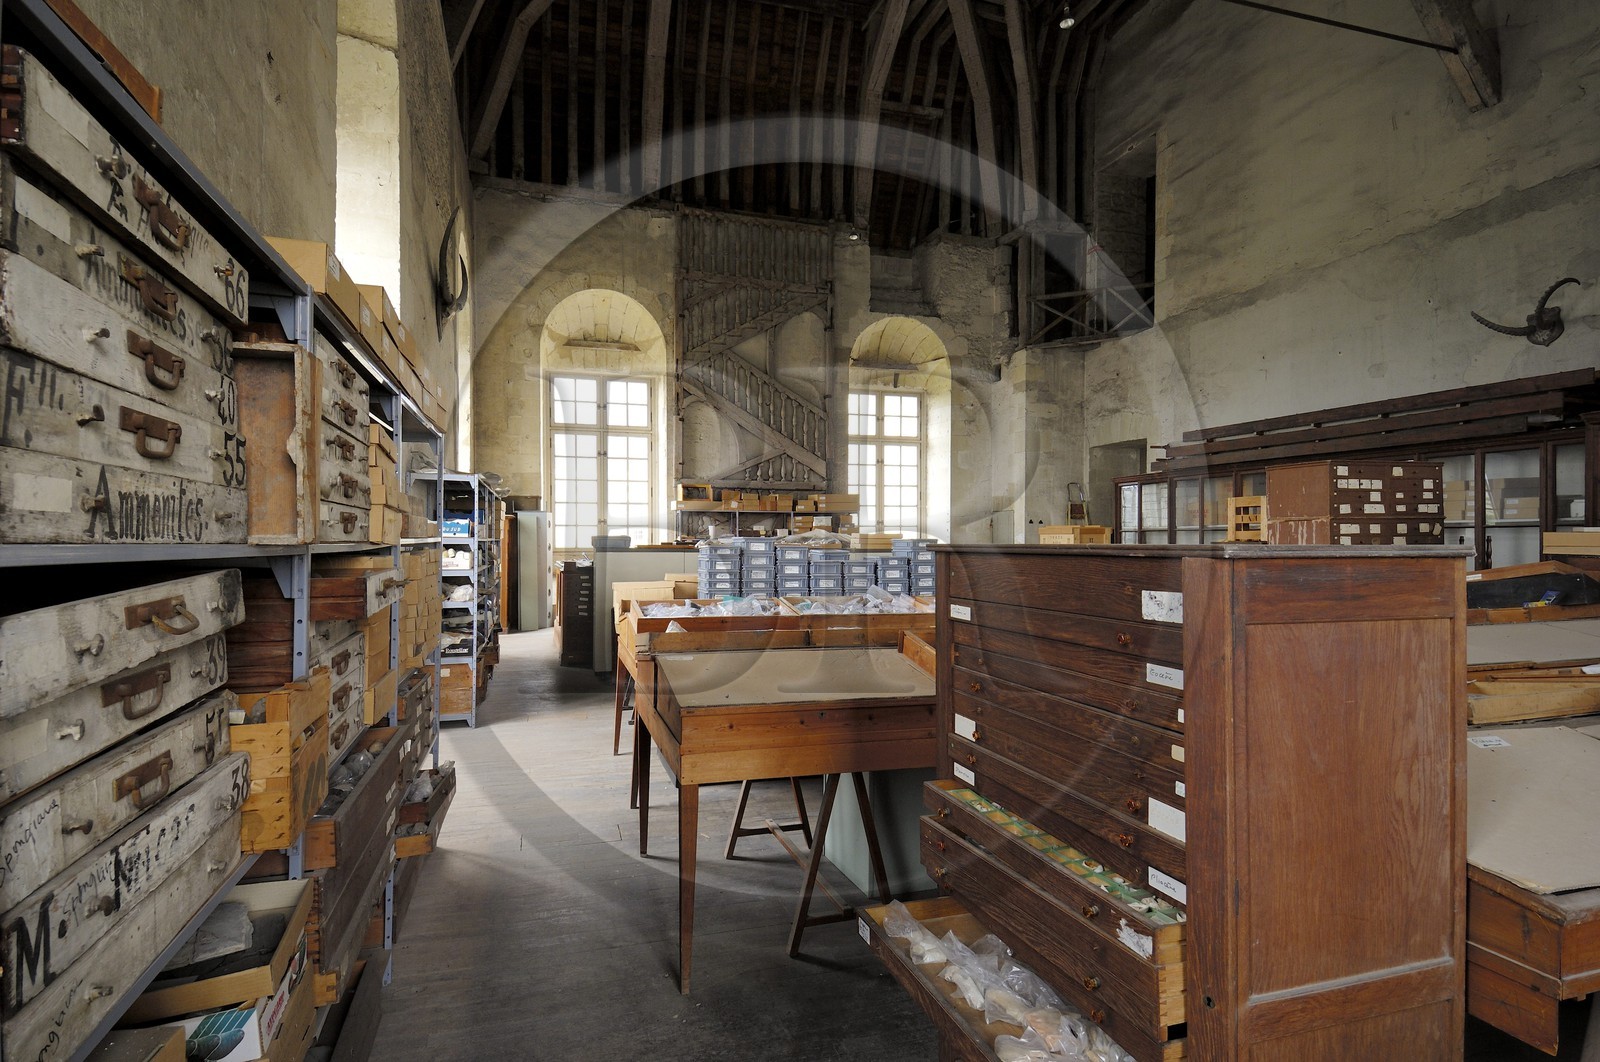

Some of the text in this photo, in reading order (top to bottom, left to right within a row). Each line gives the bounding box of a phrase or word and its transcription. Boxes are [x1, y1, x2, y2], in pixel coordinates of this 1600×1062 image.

[222, 431, 247, 487] 55
[206, 637, 226, 686] 39
[231, 758, 249, 811] 38
